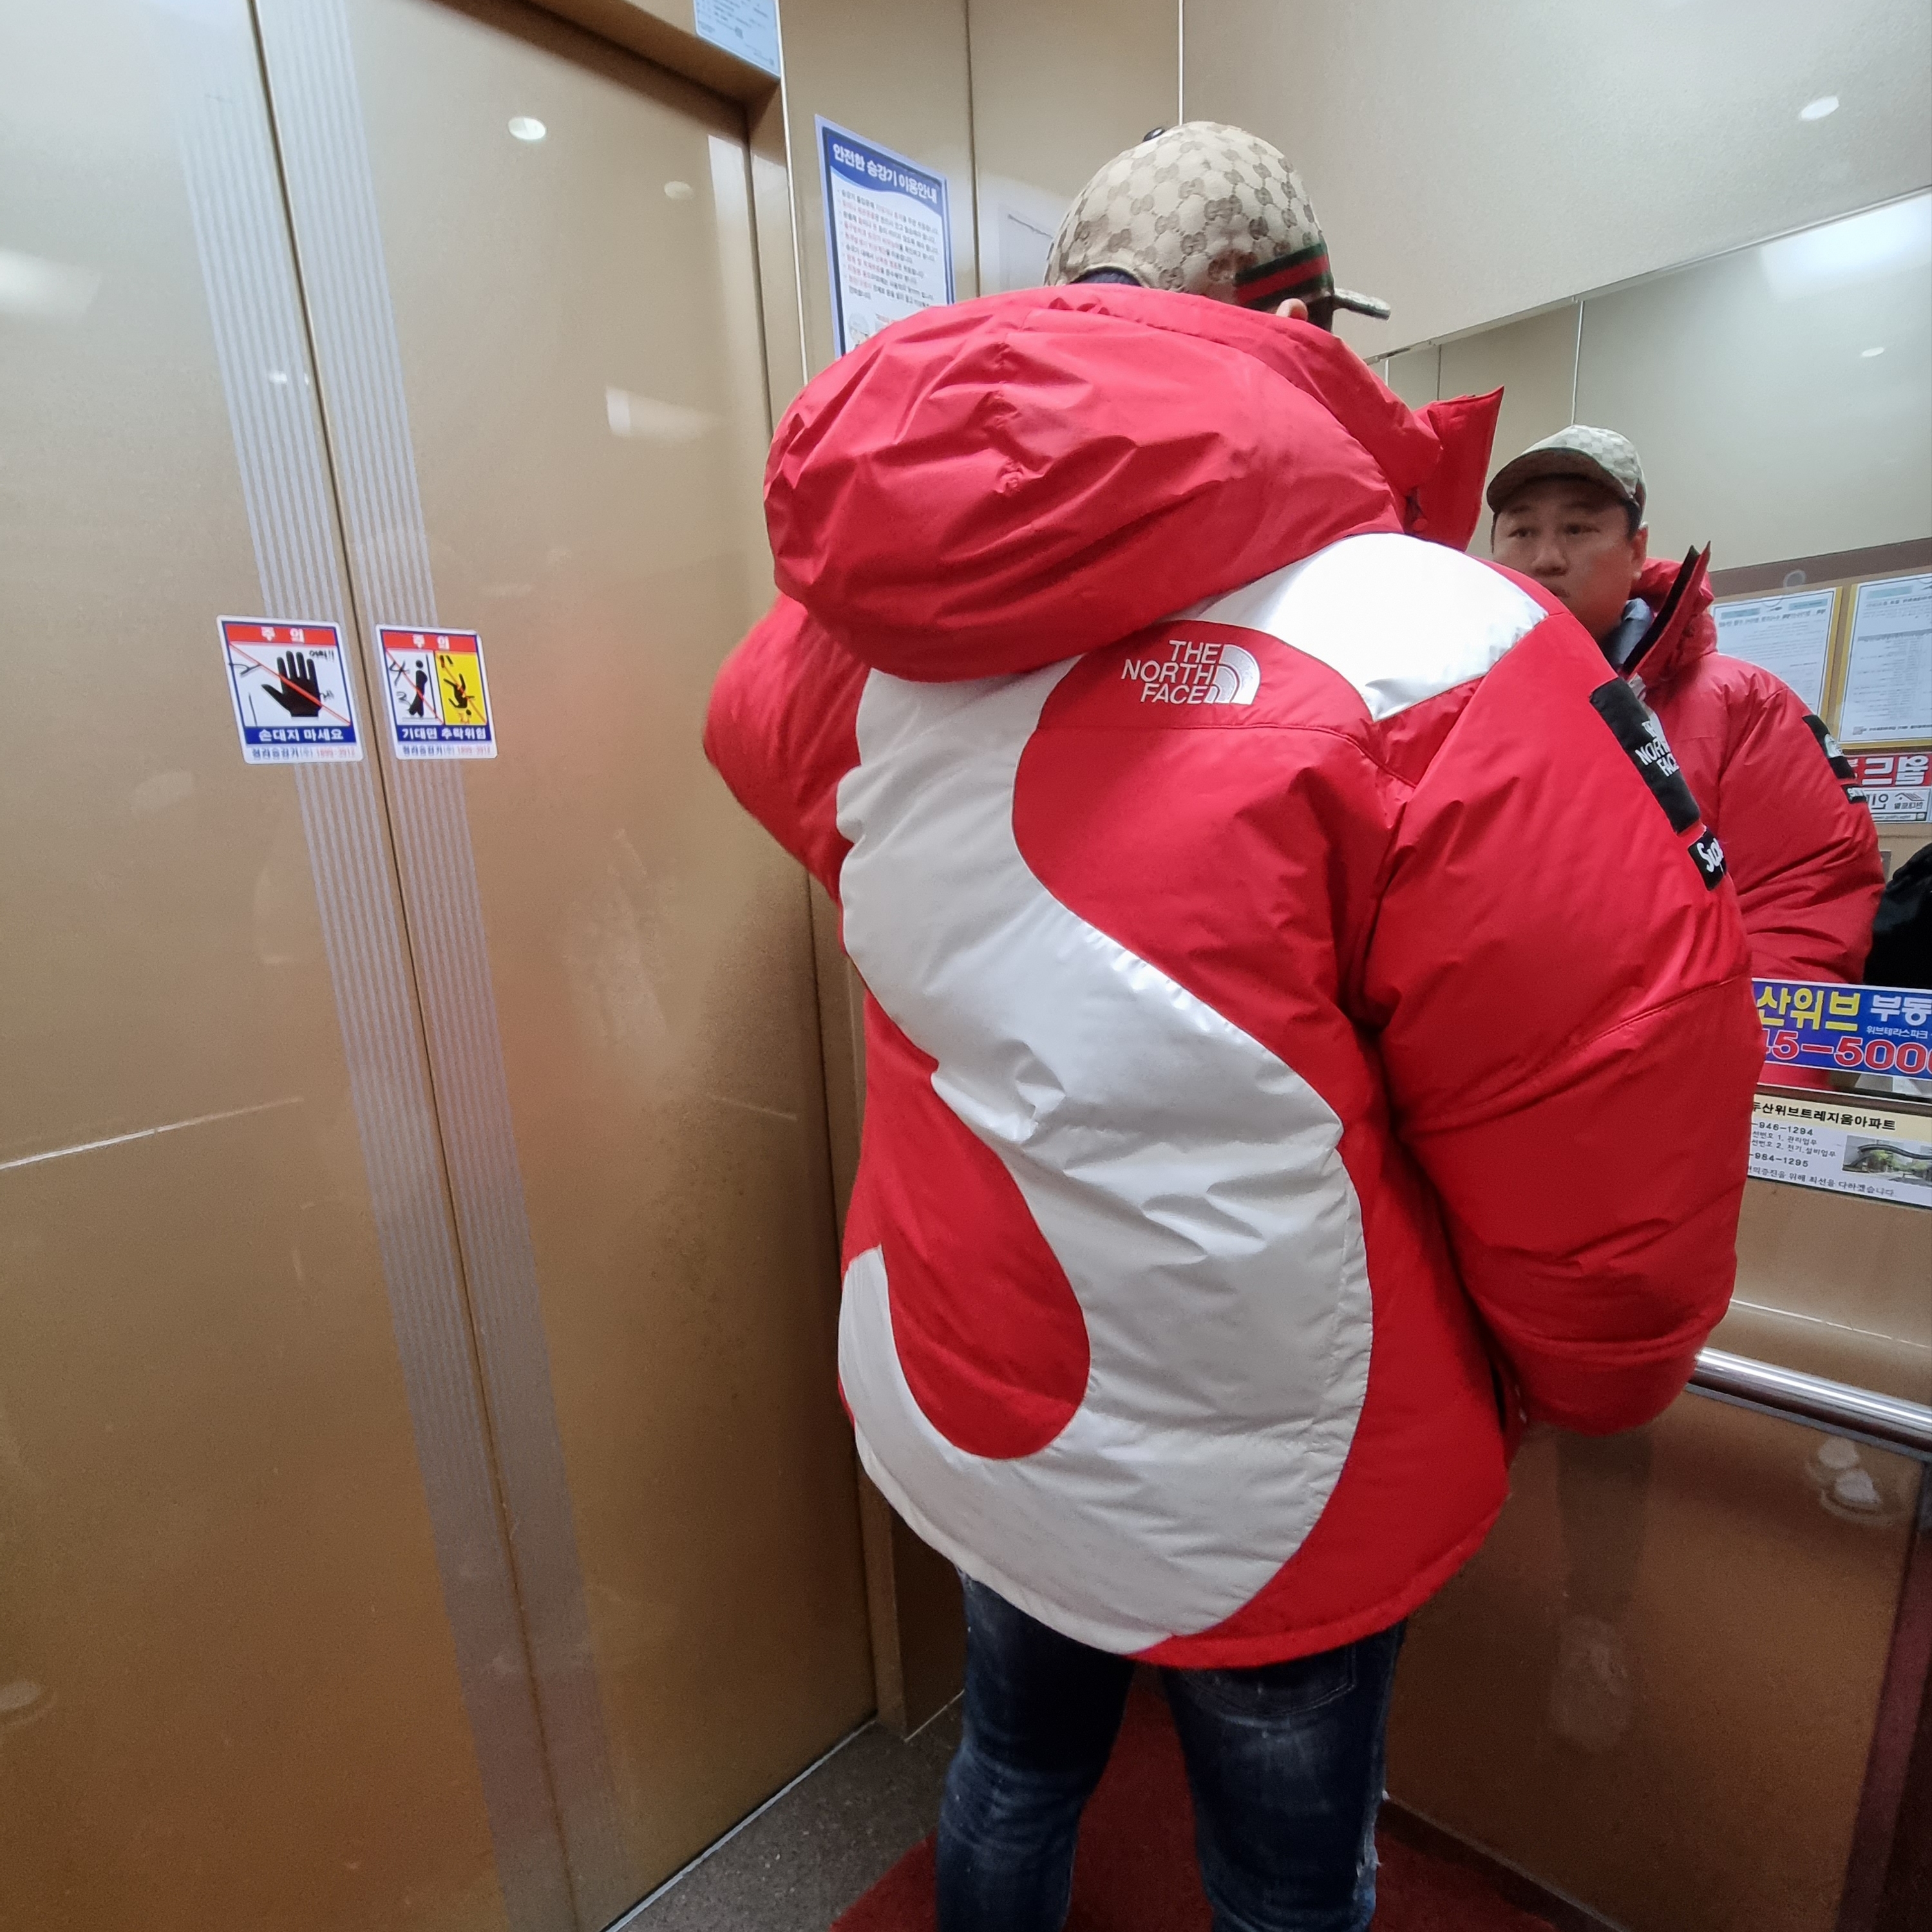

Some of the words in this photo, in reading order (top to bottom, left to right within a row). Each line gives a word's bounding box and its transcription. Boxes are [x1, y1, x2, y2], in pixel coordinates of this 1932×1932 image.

[833, 143, 866, 172] 안전한
[866, 160, 897, 187] 승강기
[898, 174, 937, 204] 이용안내
[1169, 639, 1221, 664] THE
[1121, 659, 1214, 685] NORTH
[1140, 683, 1208, 704] FACE
[259, 729, 299, 742] 손대지
[304, 728, 344, 741] 마세요
[402, 727, 438, 740] 기대면
[441, 727, 486, 740] 추락위험
[1696, 837, 1725, 873] Sup
[1866, 1025, 1928, 1039] 위브테라스파크
[1787, 1135, 1817, 1146] 관리업무
[1748, 1165, 1786, 1179] 의증진을
[1788, 1173, 1806, 1182] 위해
[1809, 1176, 1835, 1187] 최선을
